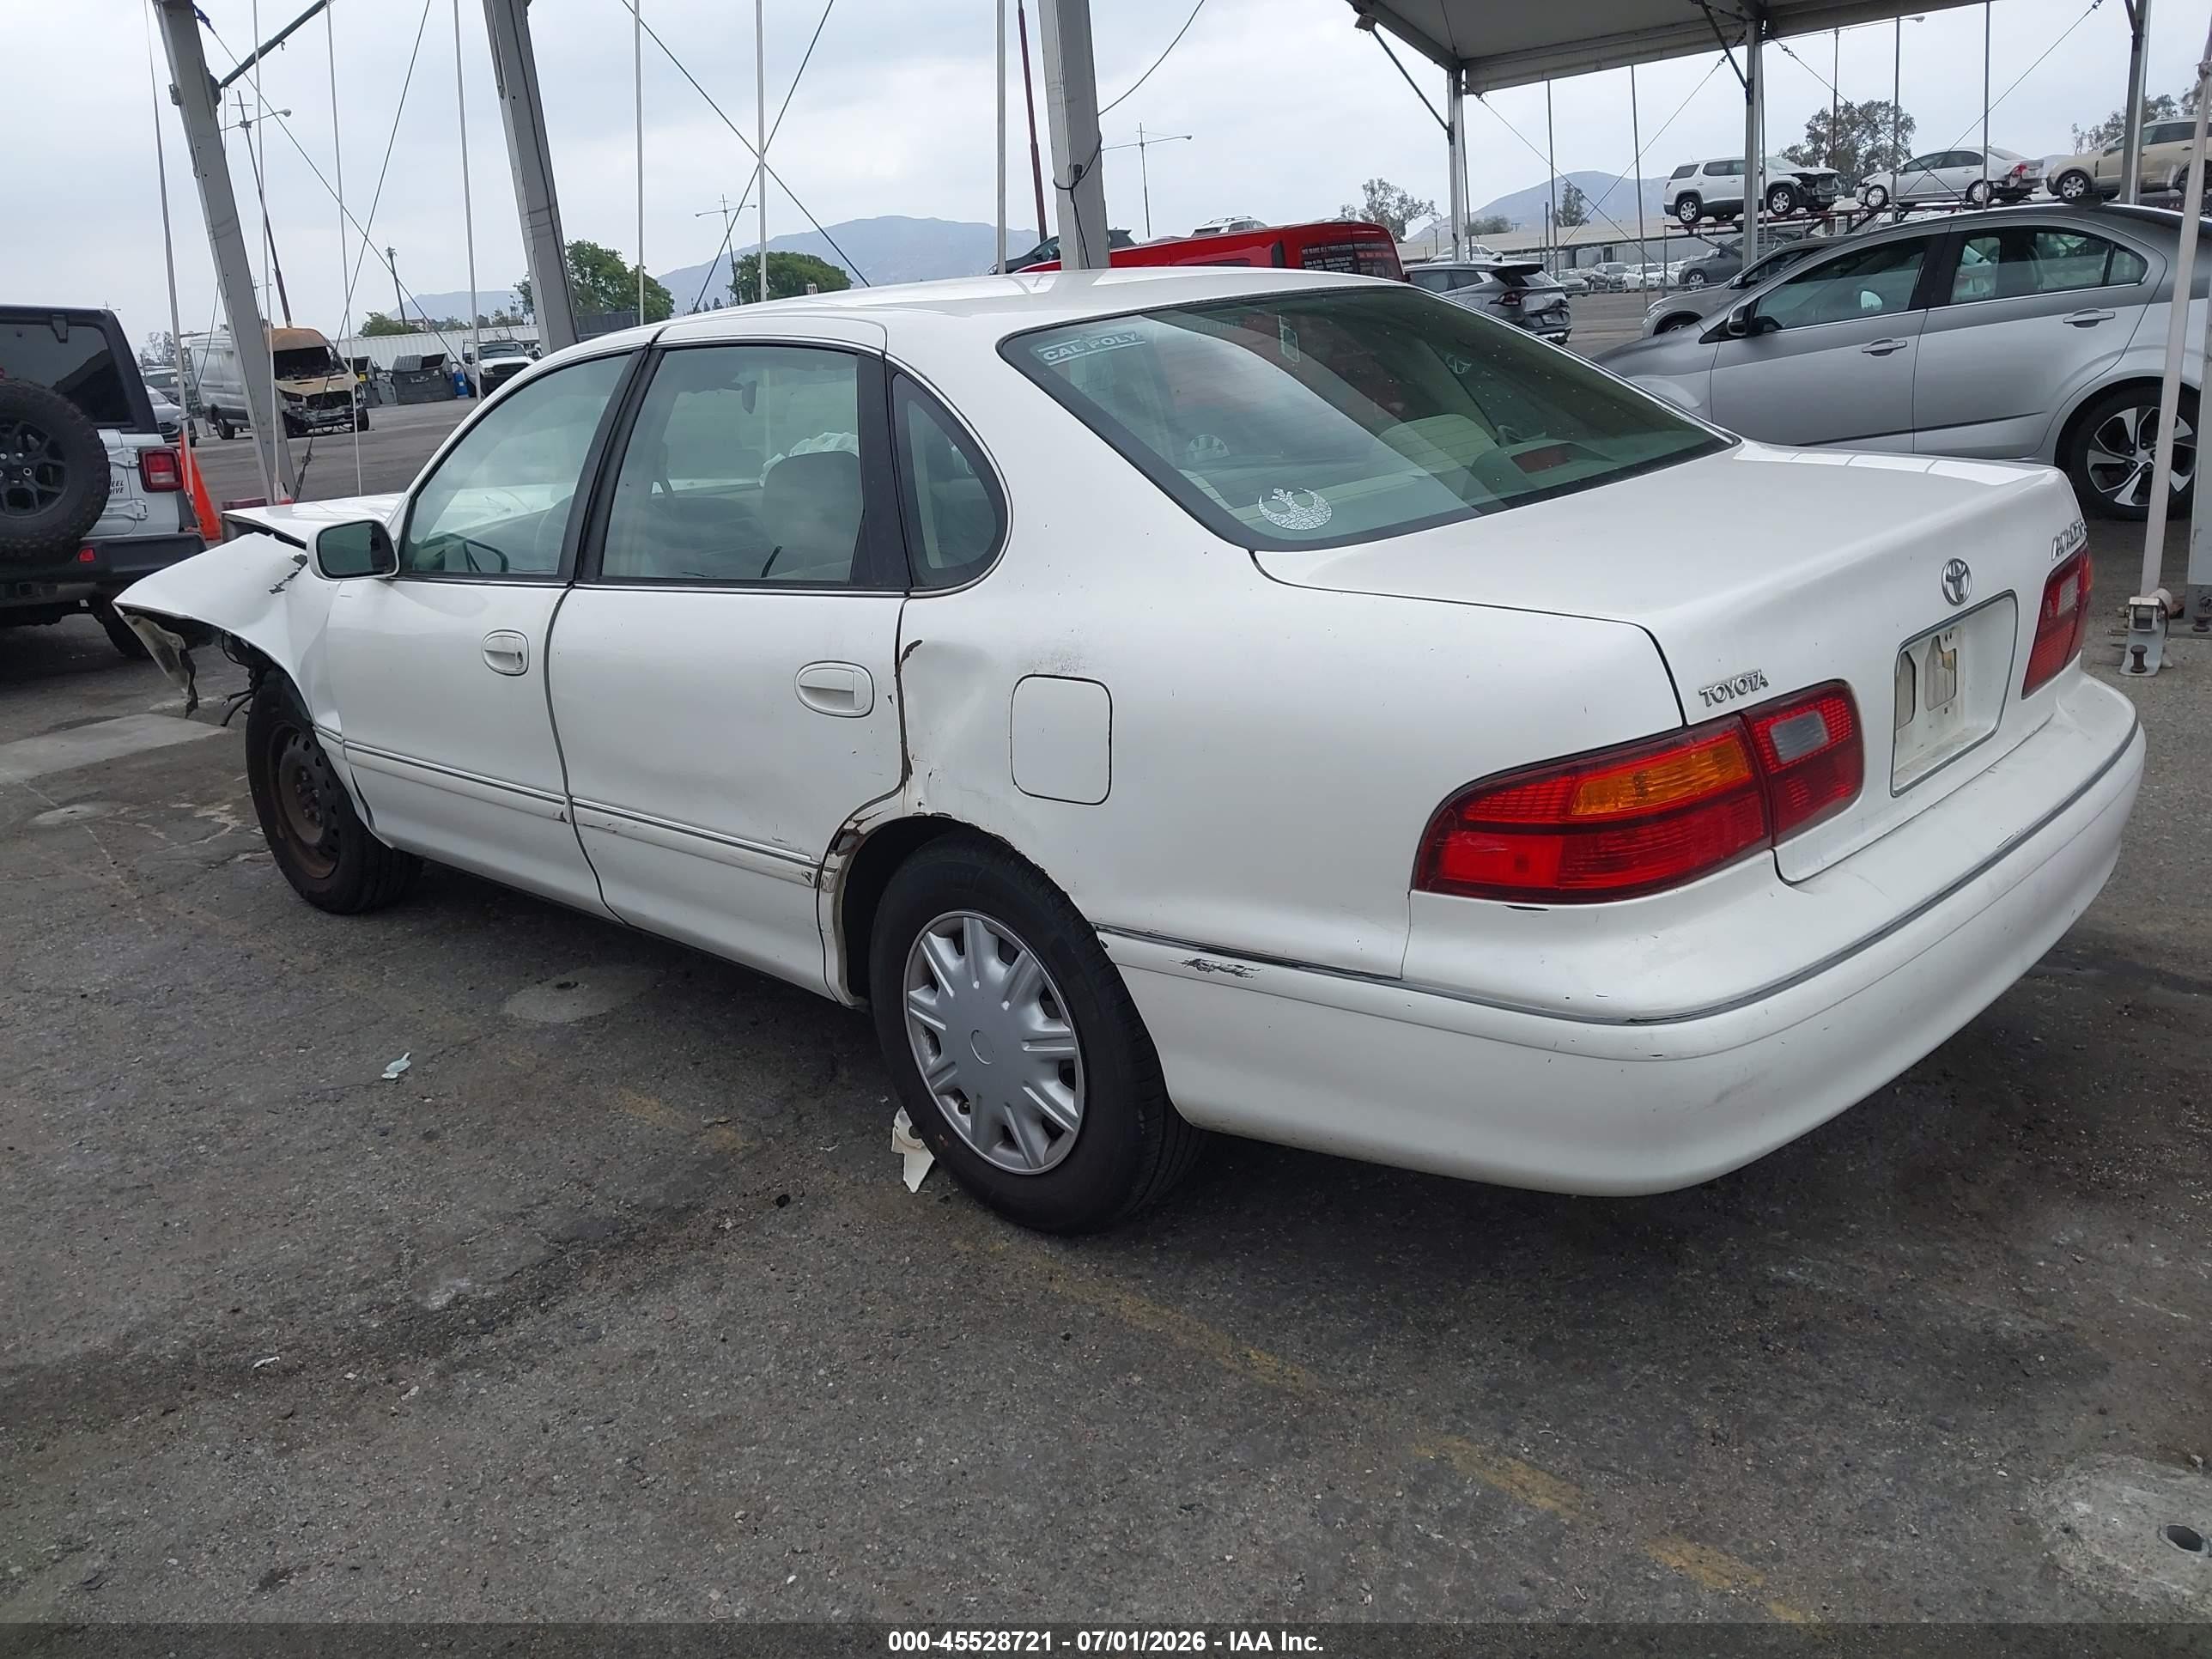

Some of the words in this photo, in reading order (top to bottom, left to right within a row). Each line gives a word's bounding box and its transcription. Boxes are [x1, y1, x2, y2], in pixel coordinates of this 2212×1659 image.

[1043, 345, 1085, 360] CAL
[1085, 332, 1138, 349] POLY
[1698, 669, 1769, 707] TOYOTA
